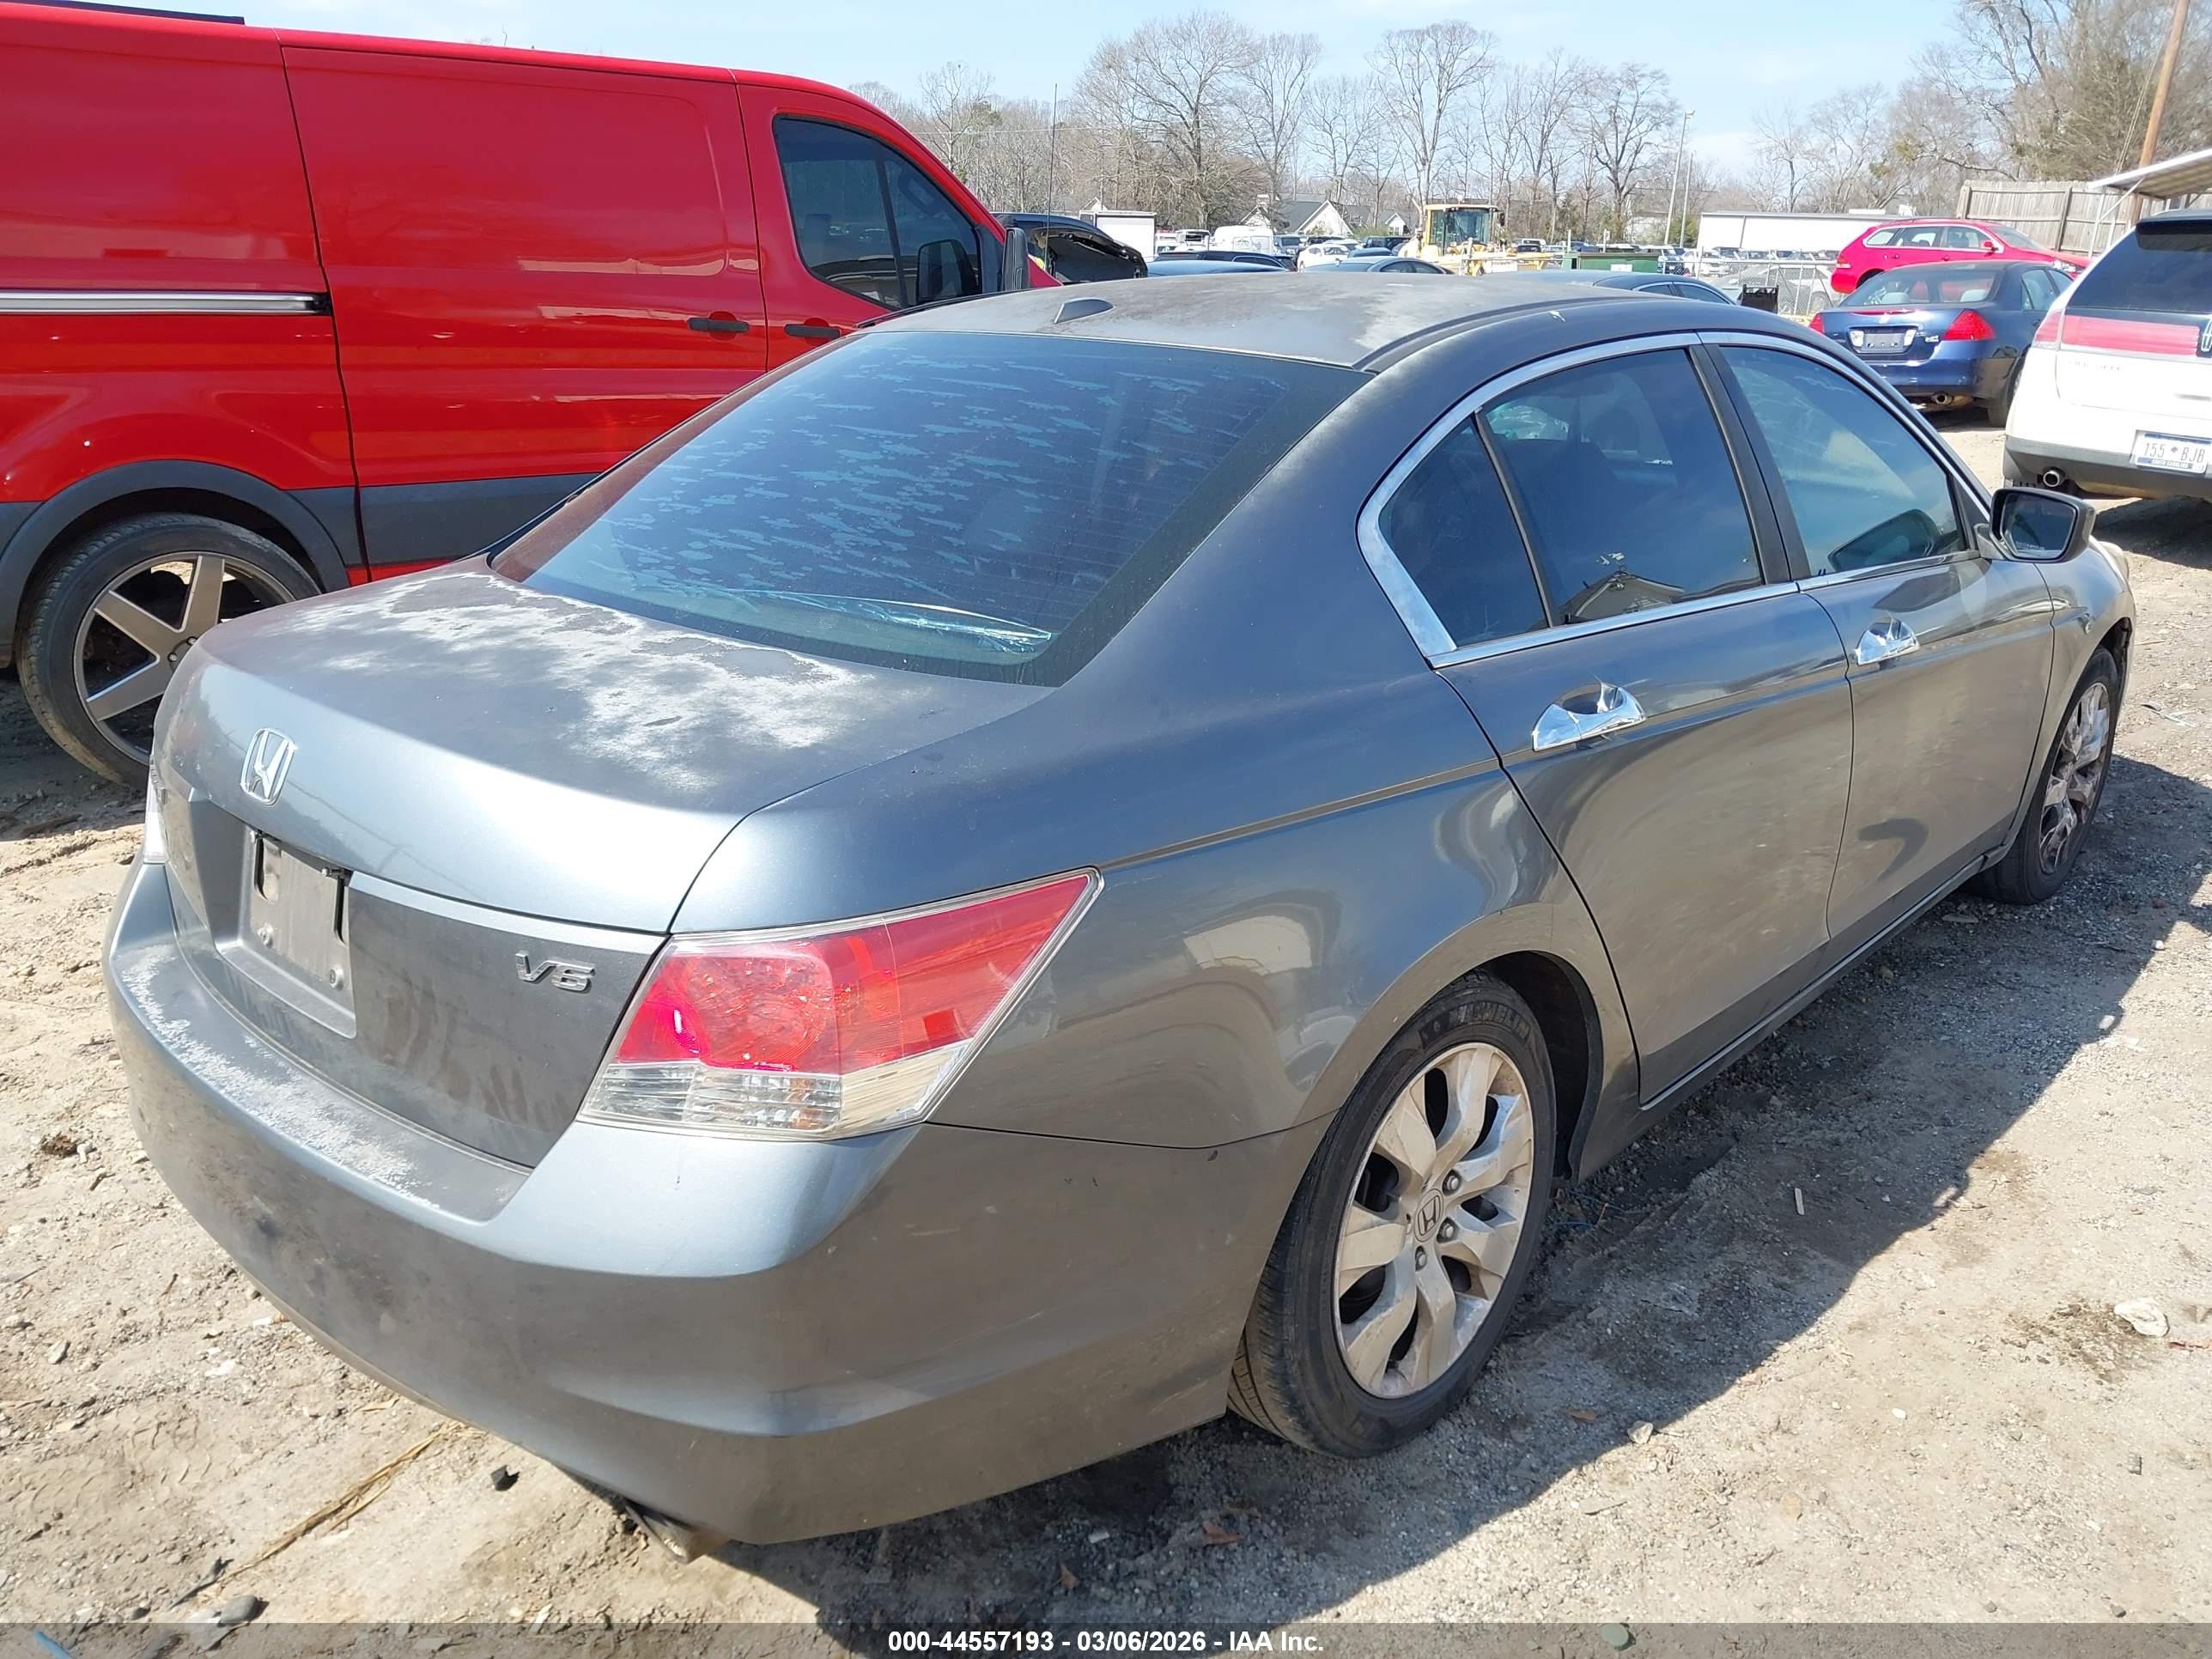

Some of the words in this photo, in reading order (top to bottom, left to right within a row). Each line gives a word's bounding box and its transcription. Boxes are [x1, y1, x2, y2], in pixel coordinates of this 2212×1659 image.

[2144, 442, 2165, 458] 155
[2181, 447, 2205, 463] BJB
[515, 951, 595, 993] V6
